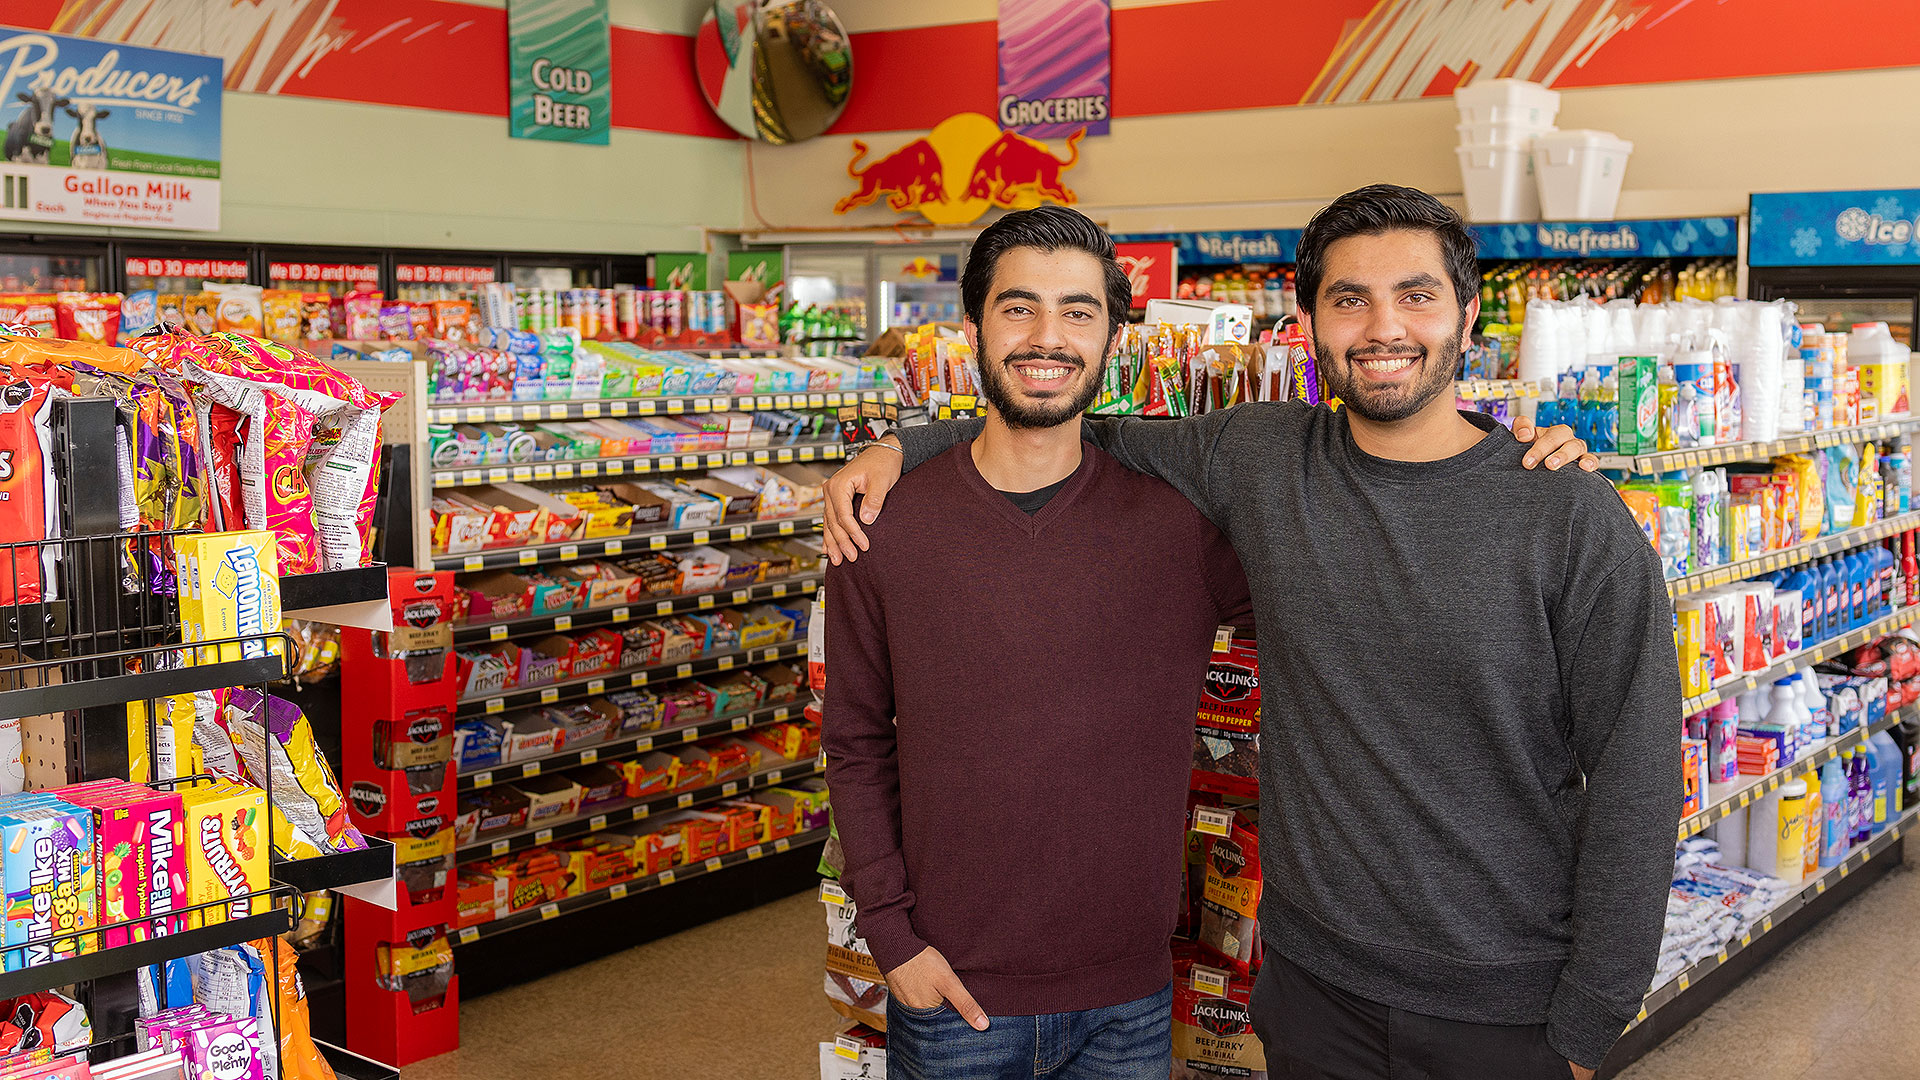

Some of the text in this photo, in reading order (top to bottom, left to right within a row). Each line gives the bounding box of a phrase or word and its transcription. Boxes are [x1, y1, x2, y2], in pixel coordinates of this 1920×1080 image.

[0, 33, 202, 106] Producers
[533, 94, 591, 129] BEER
[1000, 95, 1107, 126] GROCERIES
[64, 175, 191, 201] Gallon Milk
[1865, 214, 1912, 245] Ice
[1208, 233, 1281, 262] Refresh
[1553, 226, 1640, 256] Refresh
[126, 259, 147, 276] We
[148, 259, 163, 276] ID
[164, 260, 183, 276] 30
[184, 261, 210, 277] and
[269, 264, 288, 279] We
[289, 264, 301, 279] ID
[303, 265, 320, 280] 30
[321, 265, 344, 281] and
[397, 266, 412, 280] We
[414, 267, 425, 280] ID
[426, 267, 442, 281] 30
[444, 267, 463, 281] and
[1206, 670, 1259, 688] ACK LINK'S
[1219, 703, 1248, 716] JERKY
[1211, 713, 1225, 723] RED
[1225, 716, 1253, 727] PEPPER
[348, 787, 365, 801] JACK
[95, 833, 103, 872] Mike
[149, 808, 173, 892] Mike
[1210, 843, 1226, 860] JACK
[30, 837, 54, 884] Ike
[56, 846, 73, 884] Mix
[135, 843, 148, 881] Tropical
[31, 880, 54, 896] and
[1208, 875, 1239, 894] BEEF JERKY
[150, 888, 172, 904] and
[53, 880, 79, 954] Mega
[28, 891, 53, 968] Mike
[828, 946, 855, 963] RIGINAL
[1192, 1004, 1219, 1019] JACK
[210, 1039, 245, 1057] Good
[1195, 1036, 1245, 1051] BEEF JERKY
[227, 1053, 234, 1061] &
[1202, 1048, 1236, 1060] ORIGINAL
[211, 1055, 251, 1074] Plenty
